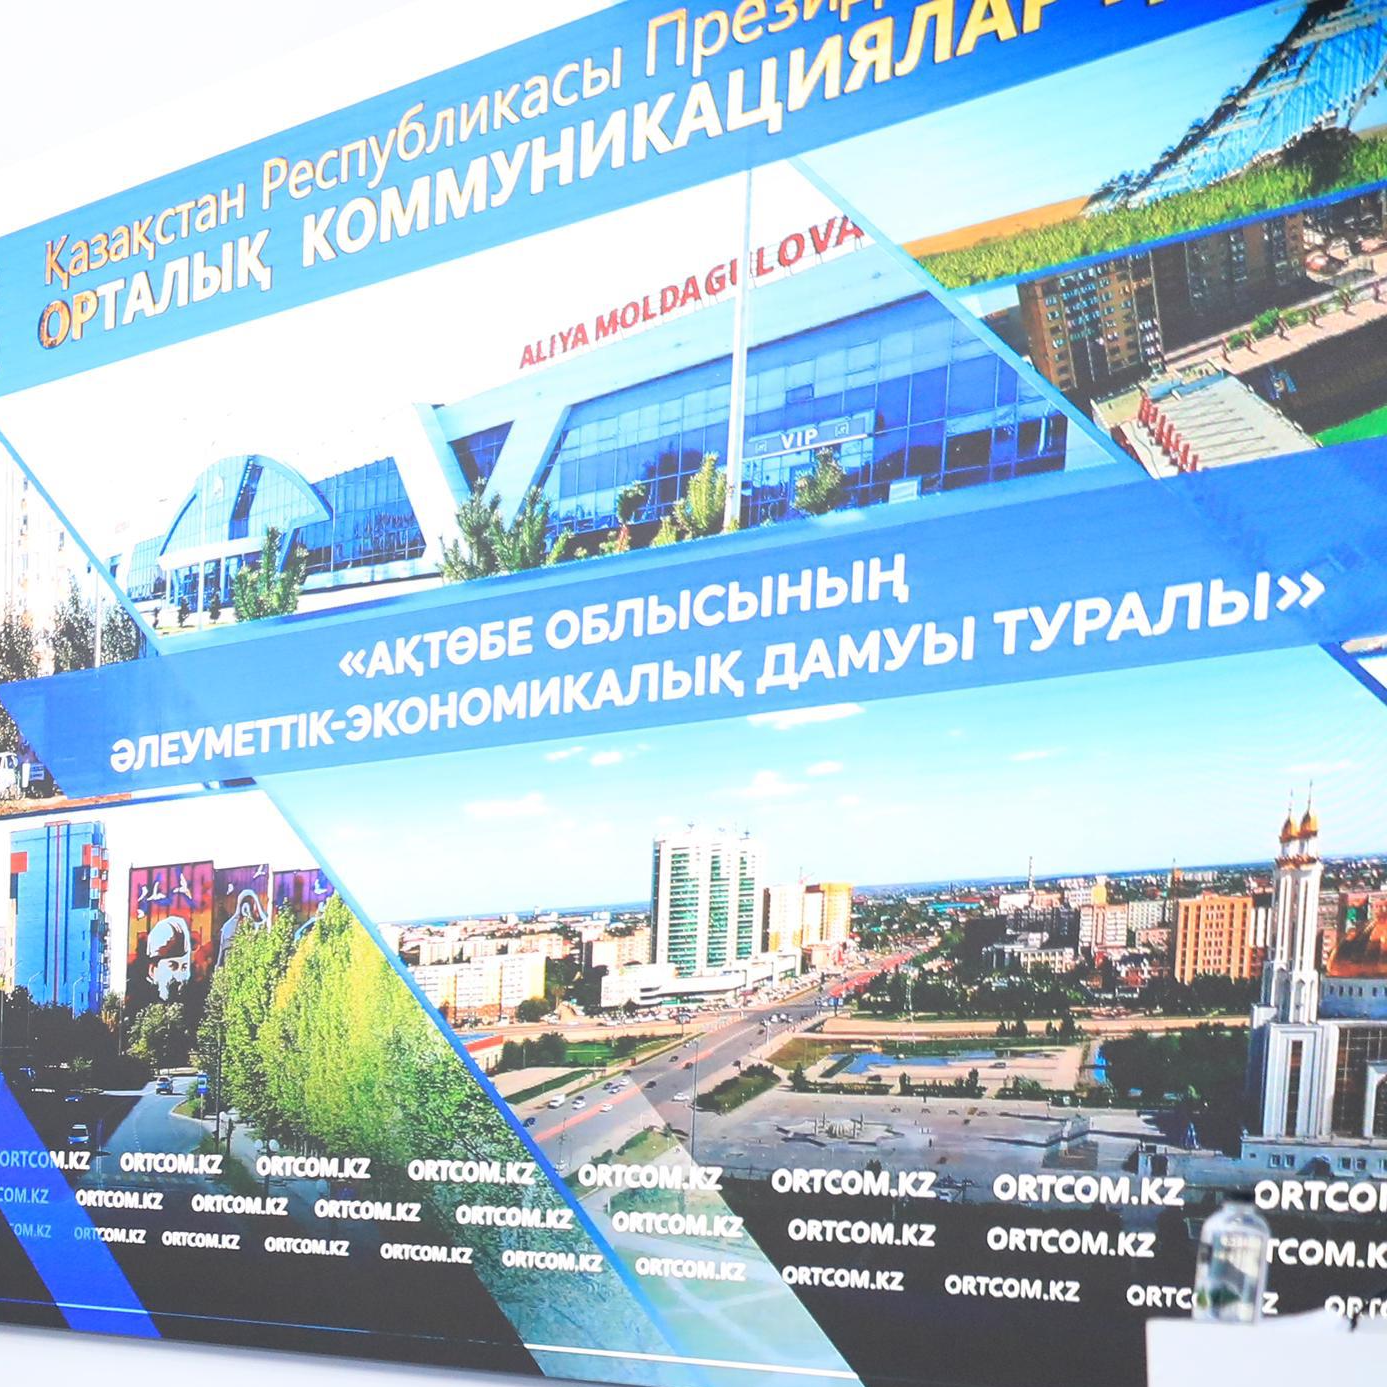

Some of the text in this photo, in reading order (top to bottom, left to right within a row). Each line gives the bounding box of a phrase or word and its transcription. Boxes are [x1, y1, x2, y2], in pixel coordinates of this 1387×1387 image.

[42, 180, 246, 292] Қазақстан
[261, 46, 623, 212] Республикасы
[37, 228, 273, 350] ОРТАЛЫҚ
[519, 322, 590, 370] ALIYA
[780, 428, 819, 450] VIP
[338, 553, 910, 678] «АҚТӨБЕ ОБЛЫСЫНЫҢ
[110, 570, 1327, 774] ӘЛЕУМЕТТІК-ЭКОНОМИКАЛЫҚ ДАМУЫ ТУРАЛЫ»
[120, 1152, 223, 1175] ORTCOM.KZ
[255, 1155, 371, 1180] ORTCOM.KZ
[407, 1159, 537, 1186] ORTCOM.KZ
[577, 1162, 724, 1194] ORTCOM.KZ
[771, 1167, 938, 1198] ORTCOM.KZ
[992, 1173, 1186, 1207] ORTCOM.KZ
[1254, 1179, 1387, 1213] ORTCO
[75, 1189, 164, 1210] ORTCOM.KZ
[191, 1193, 289, 1217] ORTCOM.KZ
[314, 1198, 422, 1223] ORTCOM.KZ
[455, 1204, 574, 1231] ORTCOM.KZ
[611, 1209, 744, 1239] ORTCOM.KZ
[787, 1217, 937, 1248] ORTCOM.KZ
[986, 1225, 1156, 1258] ORTCOM.KZ
[73, 1226, 147, 1244] ORTCOM.KZ
[161, 1230, 241, 1250] ORTCOM.KZ
[264, 1236, 350, 1257] ORTCOM.KZ
[380, 1242, 474, 1265] ORTCOM.KZ
[501, 1249, 605, 1273] ORTCOM.KZ
[634, 1254, 747, 1283] ORTCOM.KZ
[782, 1264, 905, 1293] ORTCOM.KZ
[944, 1273, 1081, 1303] ORTCOM.KZ
